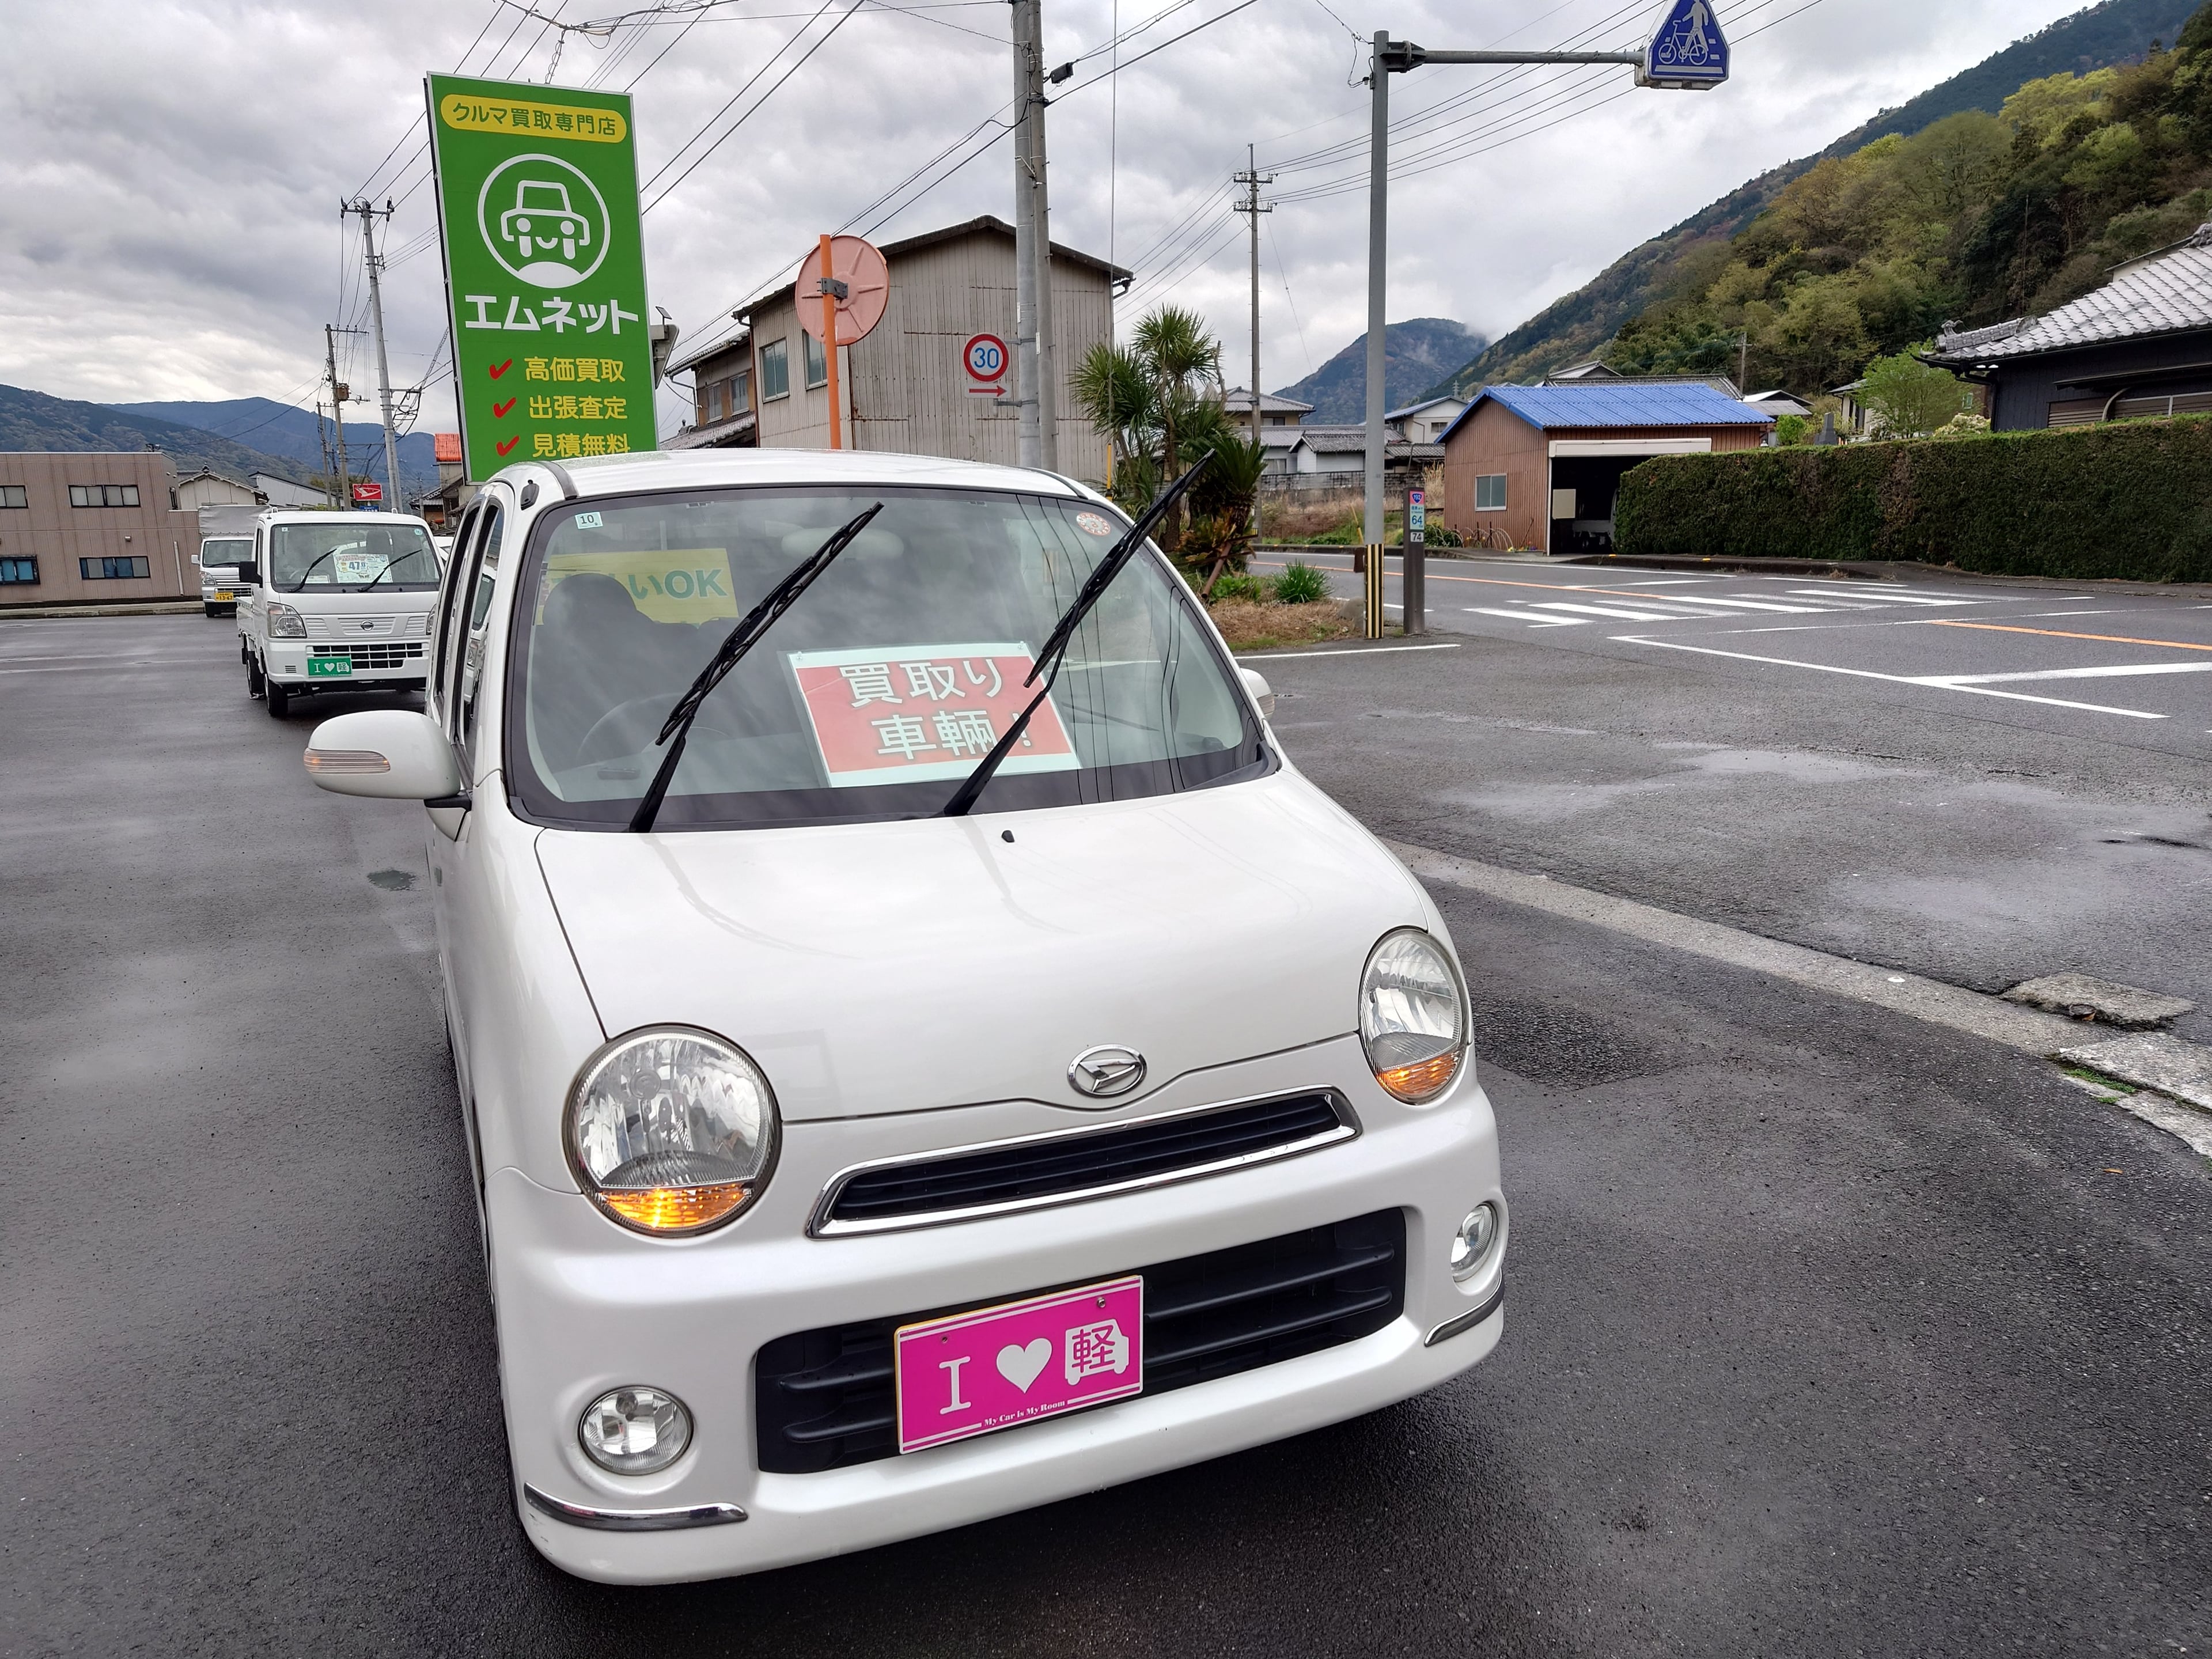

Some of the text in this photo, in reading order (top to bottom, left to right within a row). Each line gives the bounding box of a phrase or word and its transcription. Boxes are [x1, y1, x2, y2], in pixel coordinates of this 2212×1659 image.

[453, 103, 616, 136] クルマ買取専門店
[465, 294, 639, 335] エムネット
[524, 356, 626, 382] 高価買取
[974, 347, 999, 369] 30
[529, 395, 628, 419] 出張査定
[532, 433, 631, 457] 見積無料
[580, 514, 594, 524] 10
[1412, 515, 1422, 525] 64
[1412, 533, 1422, 541] 74
[839, 658, 1002, 708] 買取り
[939, 1324, 1116, 1414] I 軽
[984, 1418, 998, 1426] My
[999, 1414, 1016, 1422] Car
[1026, 1406, 1040, 1415] My
[1040, 1400, 1065, 1412] Room
